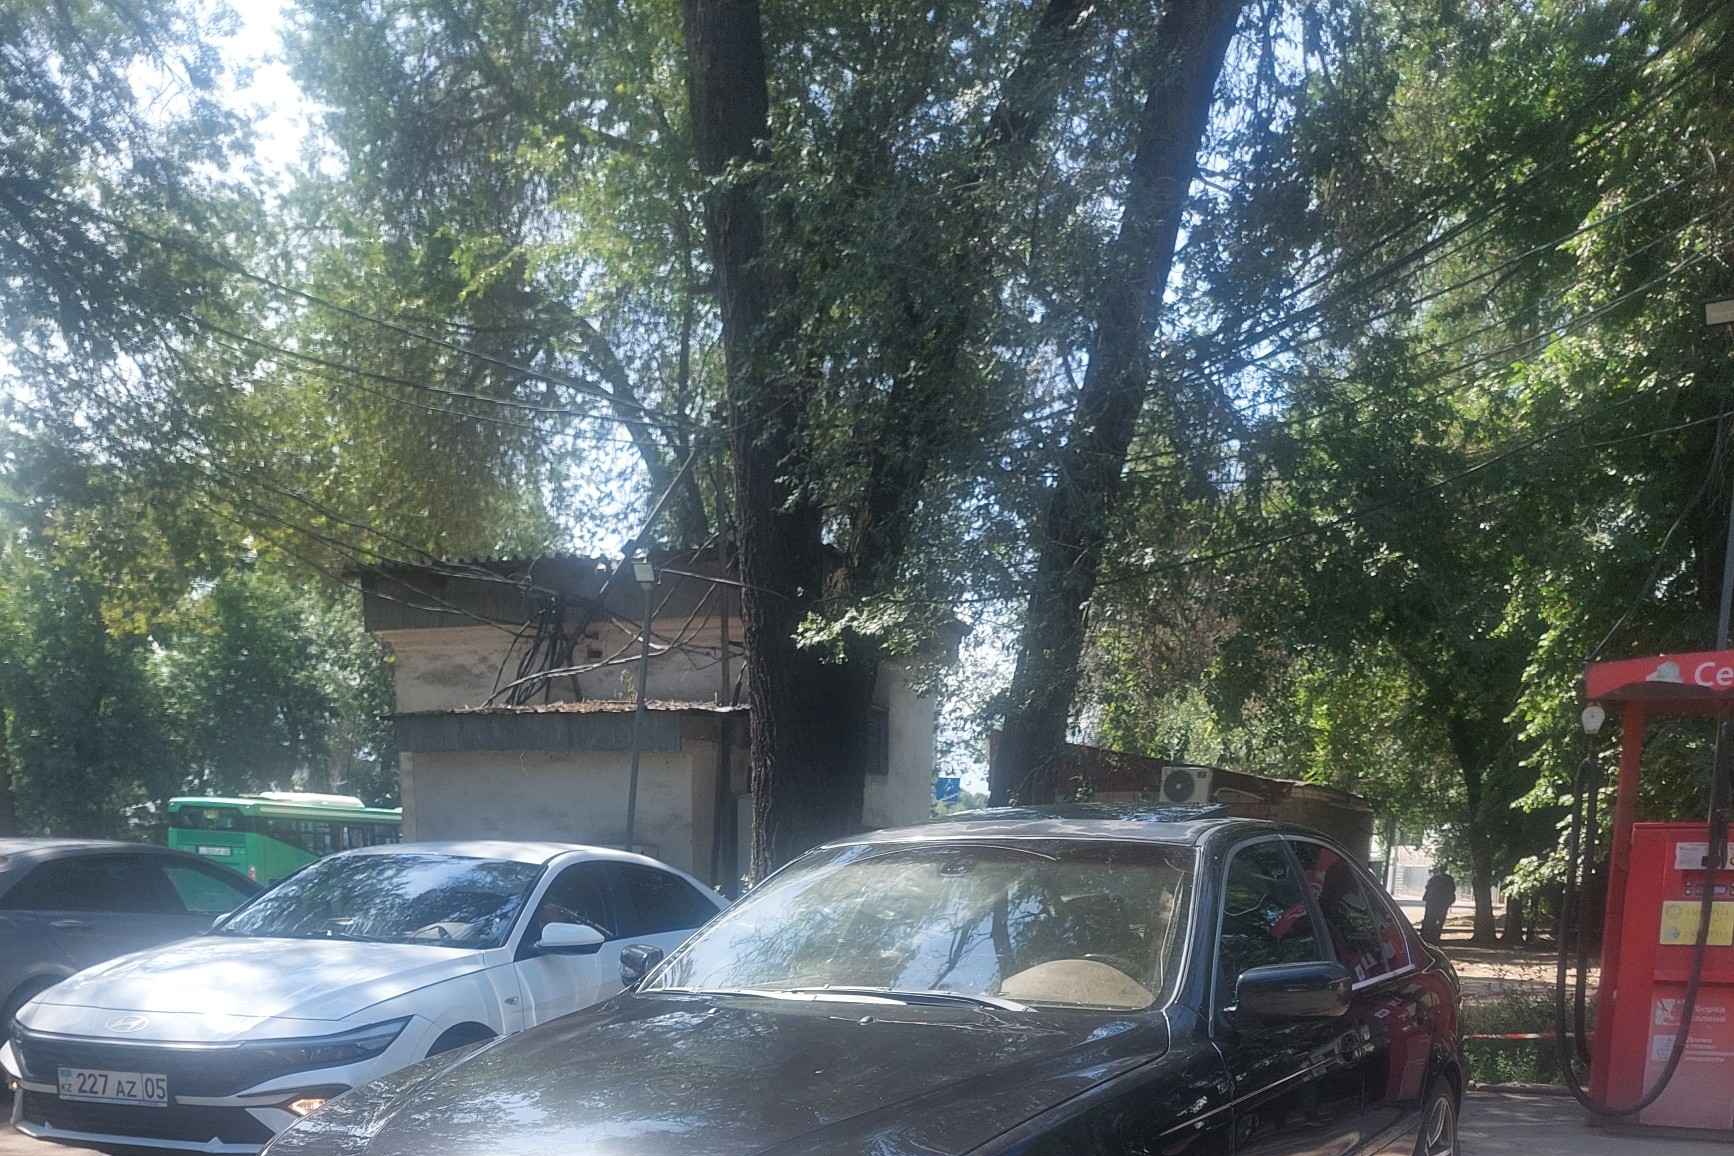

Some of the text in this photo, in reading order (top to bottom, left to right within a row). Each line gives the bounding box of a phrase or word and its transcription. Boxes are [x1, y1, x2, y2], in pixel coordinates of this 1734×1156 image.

[77, 1072, 108, 1095] 227
[116, 1080, 137, 1098] AZ
[145, 1078, 166, 1099] 05
